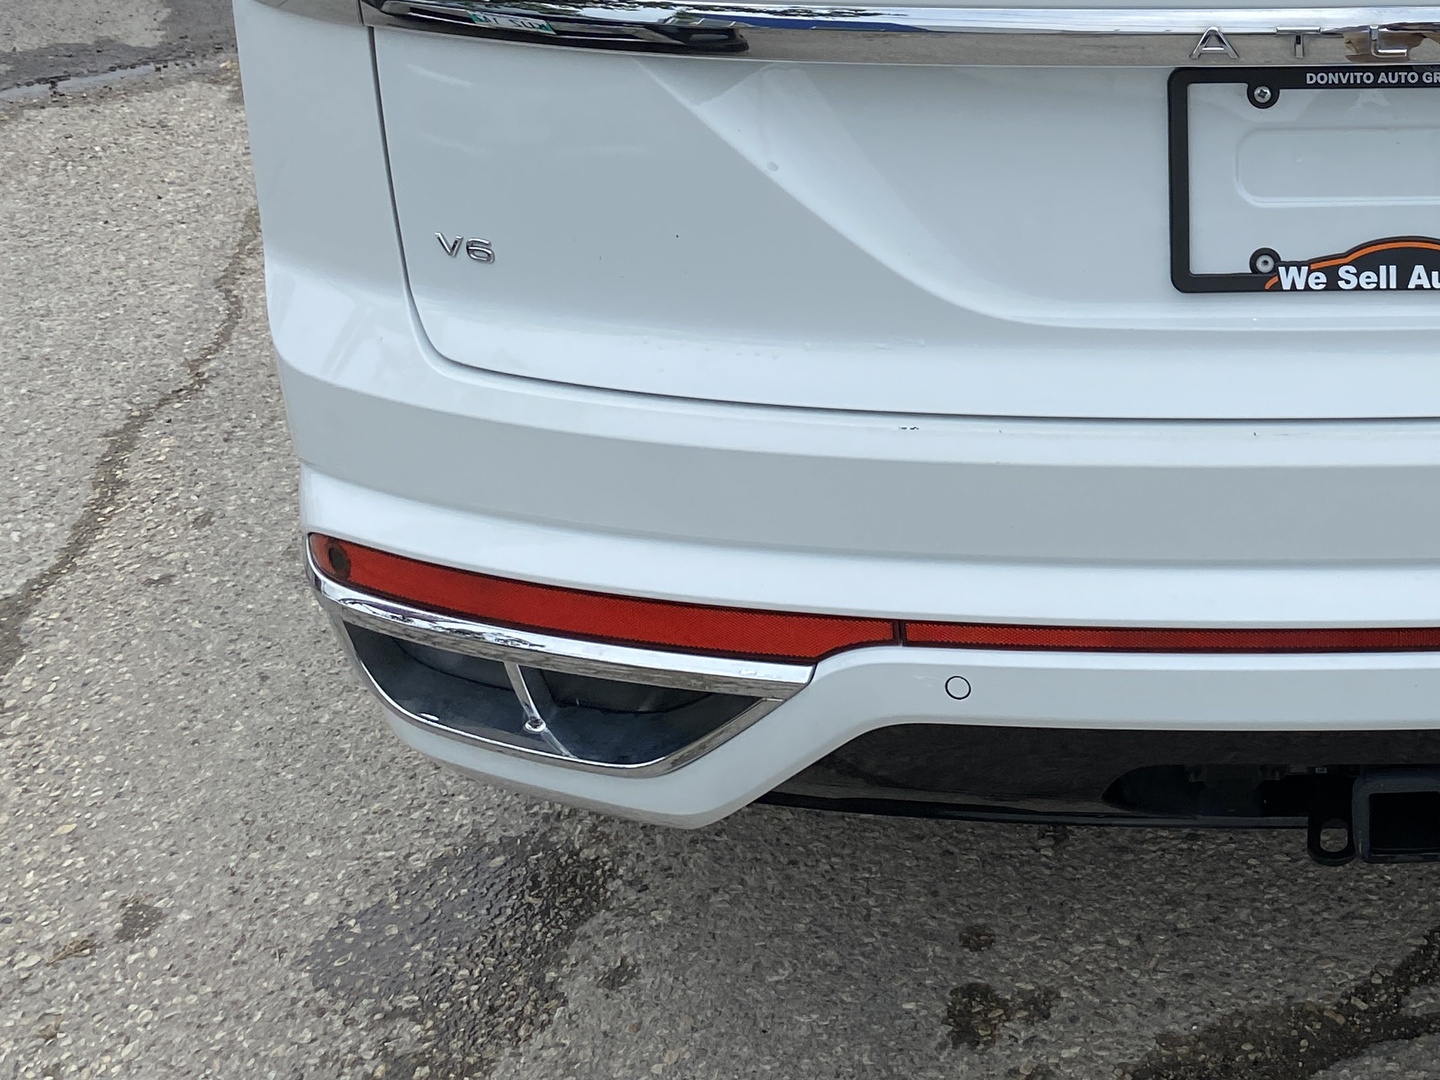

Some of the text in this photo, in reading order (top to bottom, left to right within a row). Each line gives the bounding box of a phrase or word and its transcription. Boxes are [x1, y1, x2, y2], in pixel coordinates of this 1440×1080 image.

[1306, 72, 1374, 85] DONVITO
[1377, 71, 1422, 84] AUTO
[434, 231, 496, 265] V6
[1278, 265, 1327, 291] We
[1338, 265, 1397, 290] Sell
